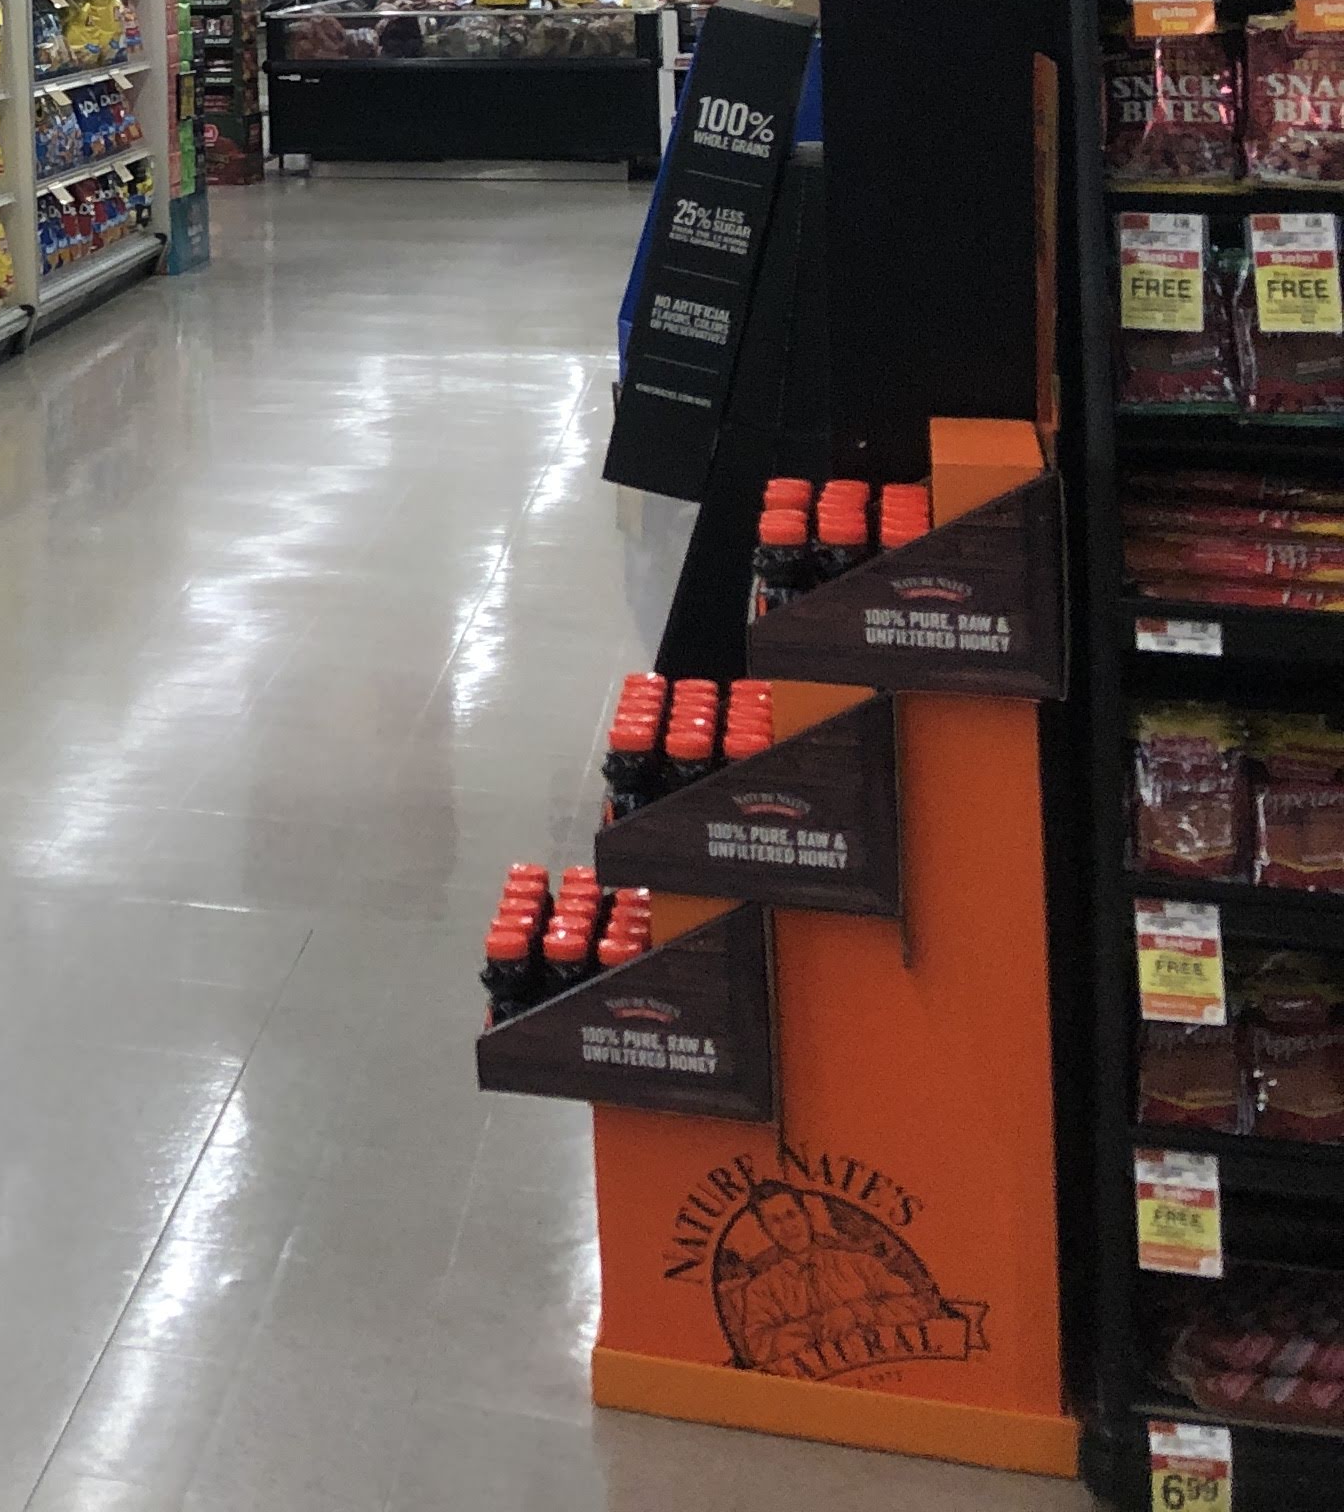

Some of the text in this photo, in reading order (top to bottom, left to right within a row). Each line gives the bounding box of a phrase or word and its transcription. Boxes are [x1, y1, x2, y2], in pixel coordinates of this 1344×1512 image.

[1111, 74, 1220, 99] SNACK
[697, 95, 775, 144] 100%
[1121, 99, 1221, 123] BITES
[693, 129, 772, 160] WHOLE GRAINS
[673, 198, 712, 231] 25%
[715, 206, 745, 225] LESS
[712, 220, 752, 239] SUGAR
[1131, 278, 1192, 299] FREE
[1266, 279, 1330, 300] FREE
[654, 294, 732, 325] NO ARTIFICIAL
[864, 608, 906, 628] 100%
[957, 614, 992, 632] RAW
[996, 616, 1010, 633] &
[865, 628, 1011, 653] UNFILTERED HONEY
[708, 822, 750, 842] 100%
[796, 829, 831, 847] RAW
[833, 831, 847, 849] &
[708, 841, 848, 869] UNFILTERED HONEY
[1154, 959, 1204, 978] FREE
[581, 1026, 620, 1046] 100%
[666, 1034, 700, 1051] RAW
[582, 1044, 717, 1073] UNFILTERED HONEY
[662, 1140, 925, 1286] NATURE NATE'S
